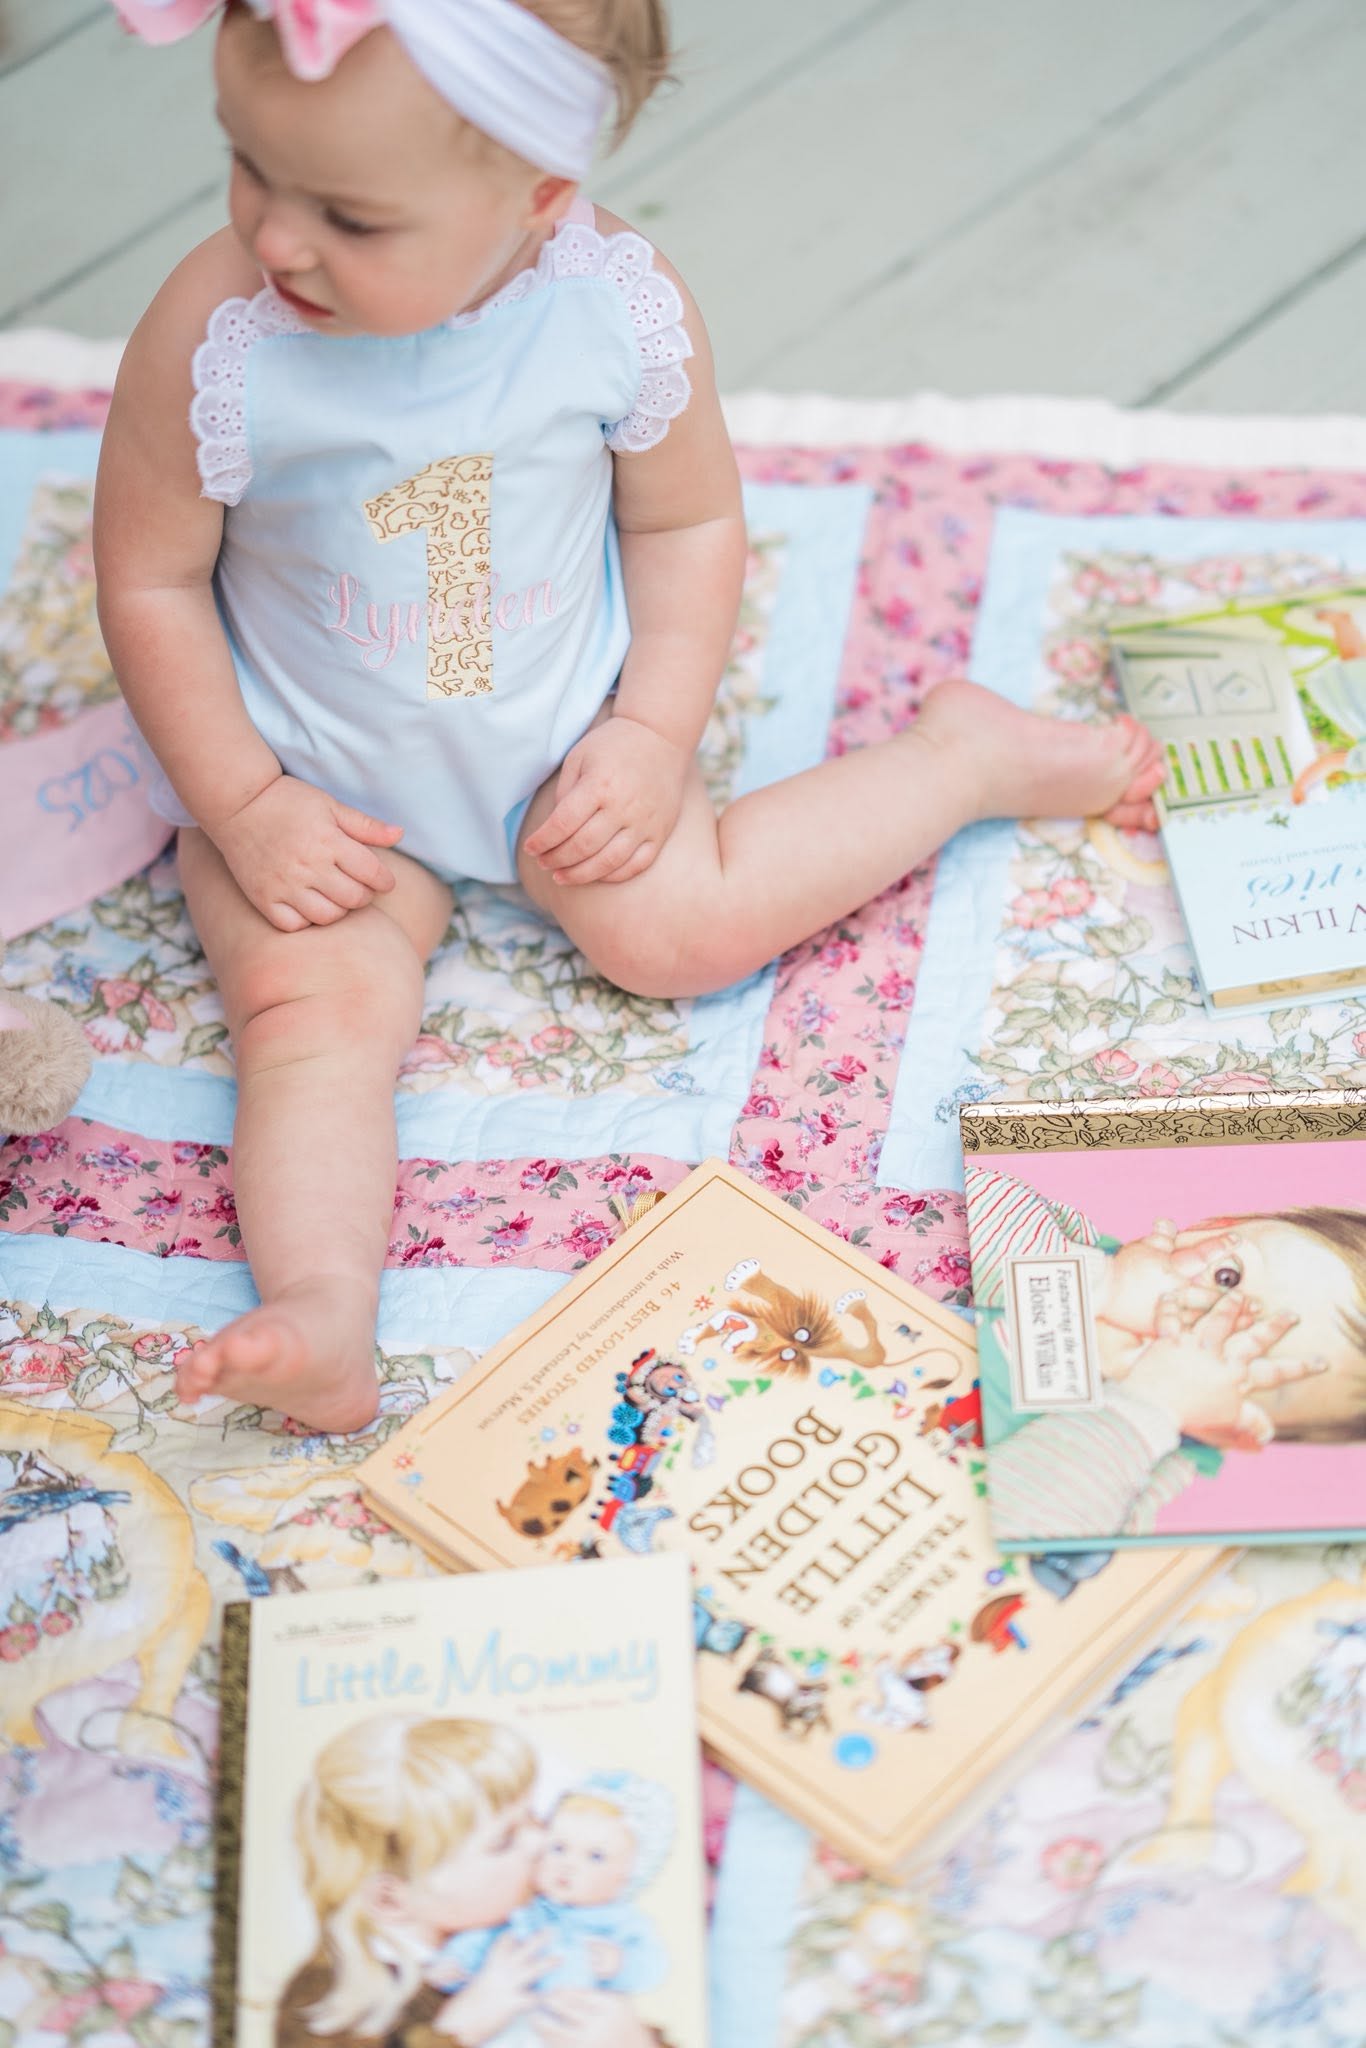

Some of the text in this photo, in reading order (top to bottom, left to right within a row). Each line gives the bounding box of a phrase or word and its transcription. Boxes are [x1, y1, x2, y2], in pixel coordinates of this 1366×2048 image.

[362, 452, 495, 698] 1
[645, 1269, 658, 1282] an
[657, 1250, 684, 1271] With
[589, 1281, 646, 1332] introduction
[1029, 1275, 1051, 1325] Eloise
[516, 1280, 681, 1424] 46 BEST-LOVED STORIES
[531, 1341, 581, 1385] Leonard
[577, 1331, 593, 1342] by
[688, 1406, 843, 1543] BOOKS
[719, 1431, 901, 1592] GOLDEN
[776, 1473, 943, 1616] LITTLE
[296, 1628, 660, 1708] Little Mommy
